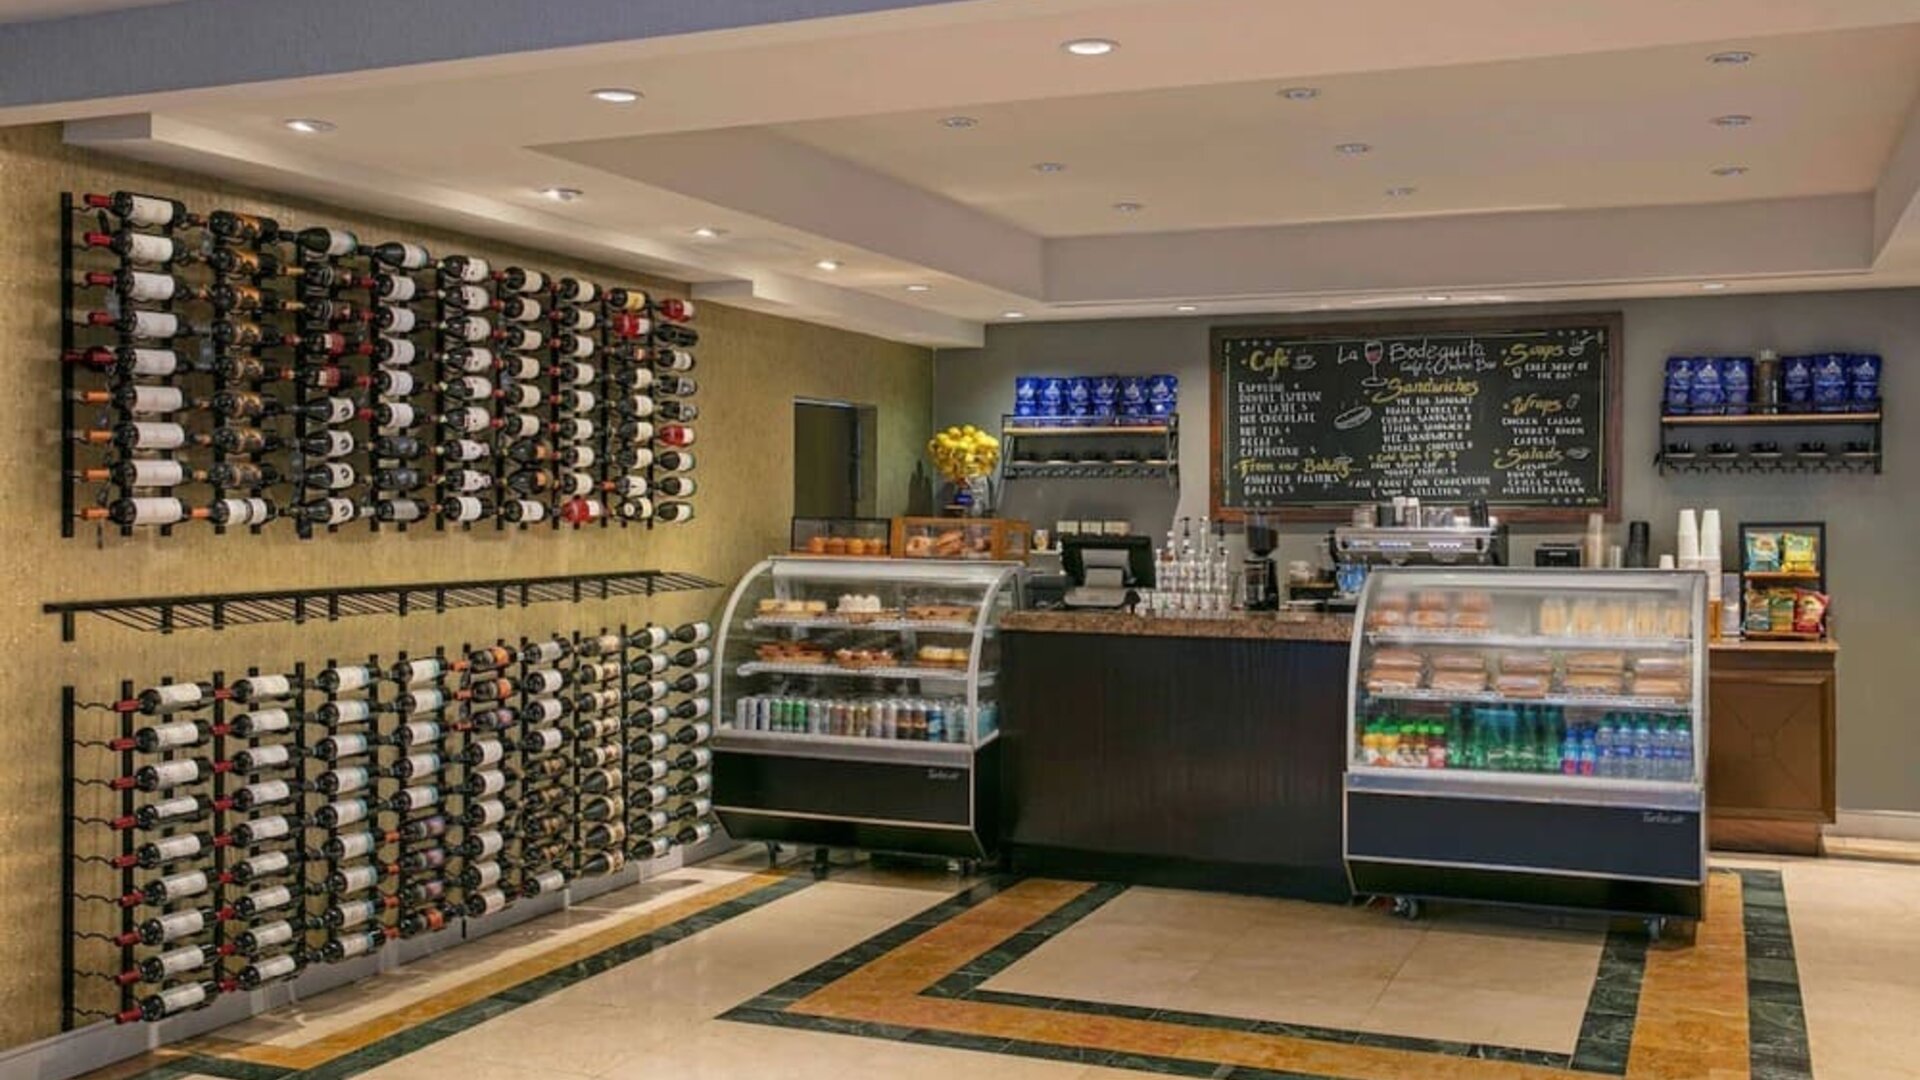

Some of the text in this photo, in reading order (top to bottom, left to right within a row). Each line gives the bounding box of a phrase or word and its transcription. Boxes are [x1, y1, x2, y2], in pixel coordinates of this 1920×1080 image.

[1338, 337, 1486, 374] La Bodeguita
[1475, 358, 1497, 372] Bar
[1503, 343, 1564, 366] Soups
[1371, 377, 1479, 403] Sandwiches
[1511, 393, 1563, 416] Wraps
[1259, 412, 1317, 424] CHOCOLATE
[1546, 416, 1583, 425] CAESAR
[1493, 447, 1566, 470] Salads
